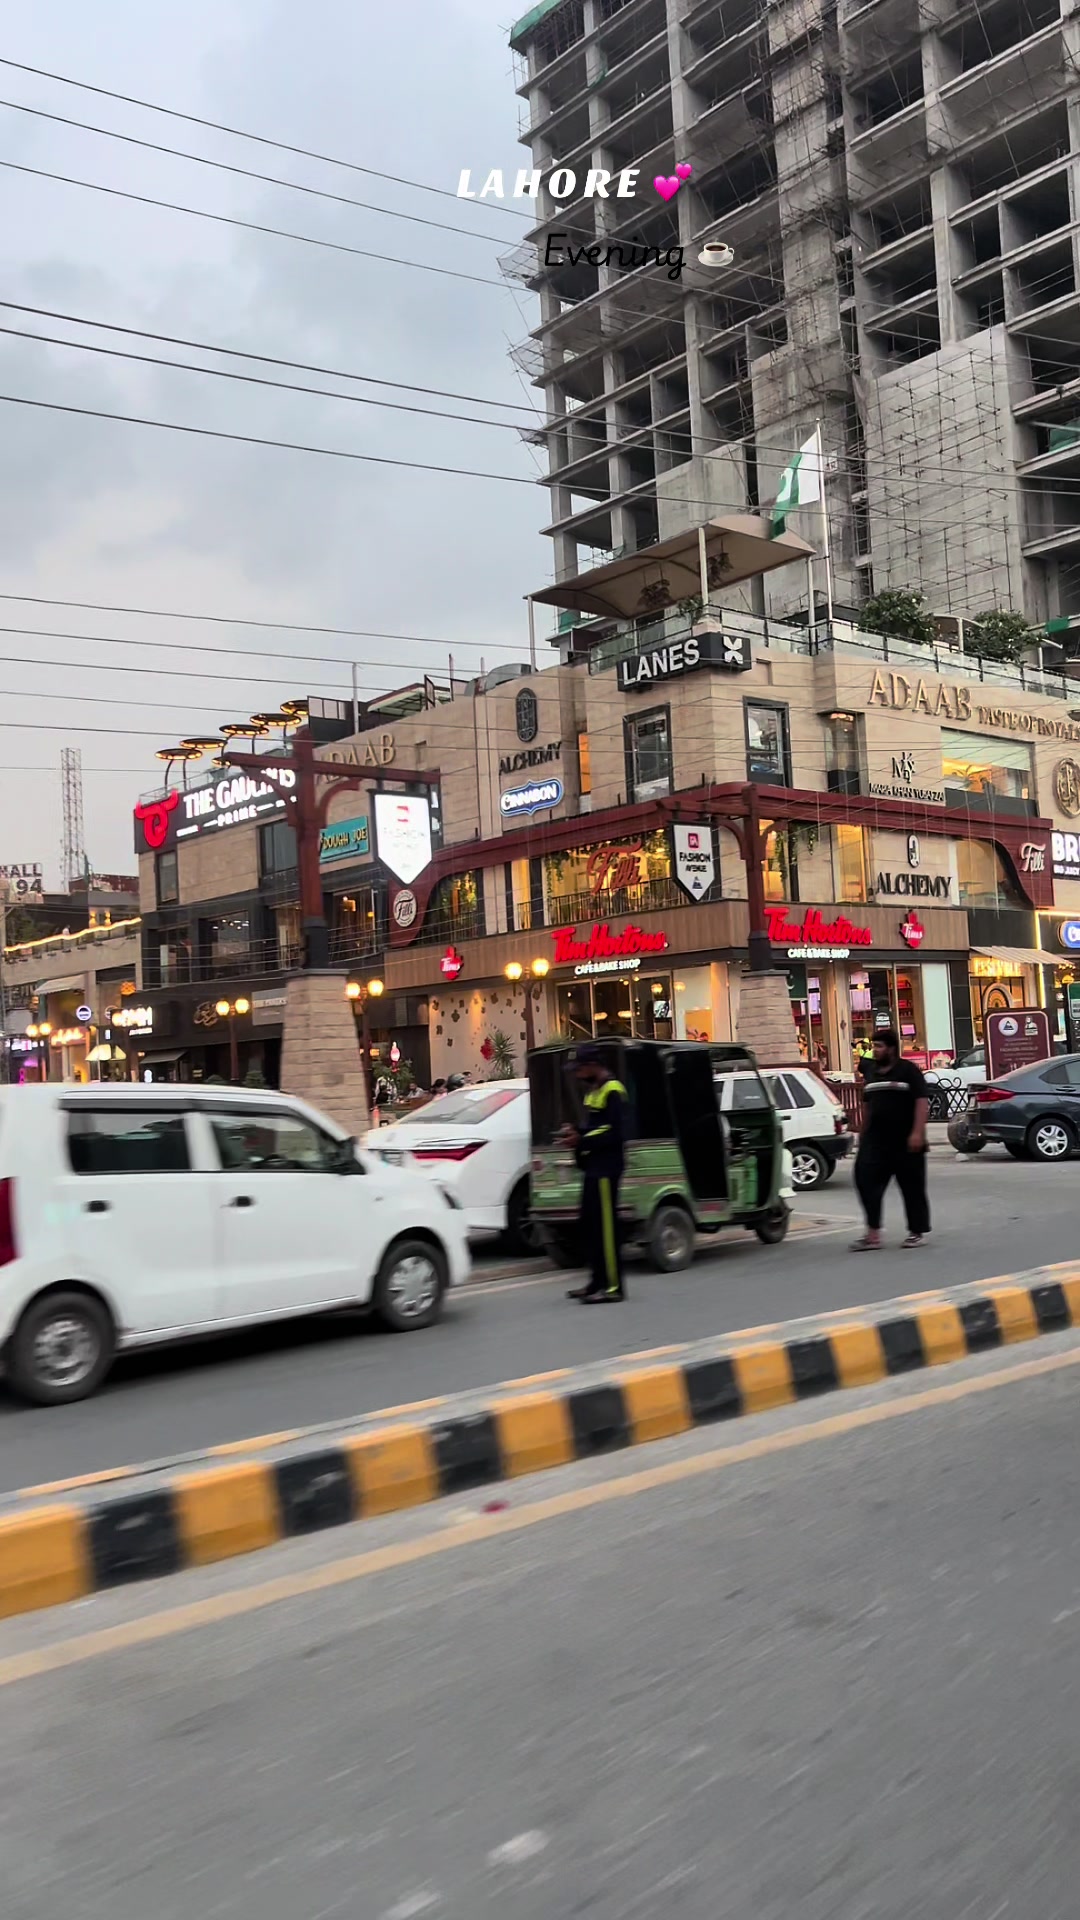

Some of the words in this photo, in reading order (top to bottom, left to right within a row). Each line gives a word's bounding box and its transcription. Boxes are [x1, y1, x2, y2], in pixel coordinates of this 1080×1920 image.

[622, 639, 700, 686] LANES
[867, 668, 972, 721] ADAAB
[977, 706, 1017, 731] TASTE
[1019, 715, 1036, 733] OF
[498, 741, 562, 776] ALCHEMY
[184, 787, 216, 819] THE
[501, 783, 557, 810] CINNABON
[217, 804, 257, 827] PRIME
[324, 832, 350, 850] DOUGH
[352, 827, 367, 843] JOE
[1051, 833, 1080, 863] BR
[586, 838, 643, 896] Filli
[679, 851, 711, 863] FASHION
[1020, 842, 1047, 872] Filli
[16, 878, 42, 895] 94
[877, 871, 953, 898] ALCHEMY
[763, 907, 800, 942] Tim
[801, 907, 872, 946] Hortons
[903, 922, 922, 939] Tims
[551, 926, 588, 963] Tim
[587, 923, 666, 959] Hortons
[619, 958, 641, 970] SHOP
